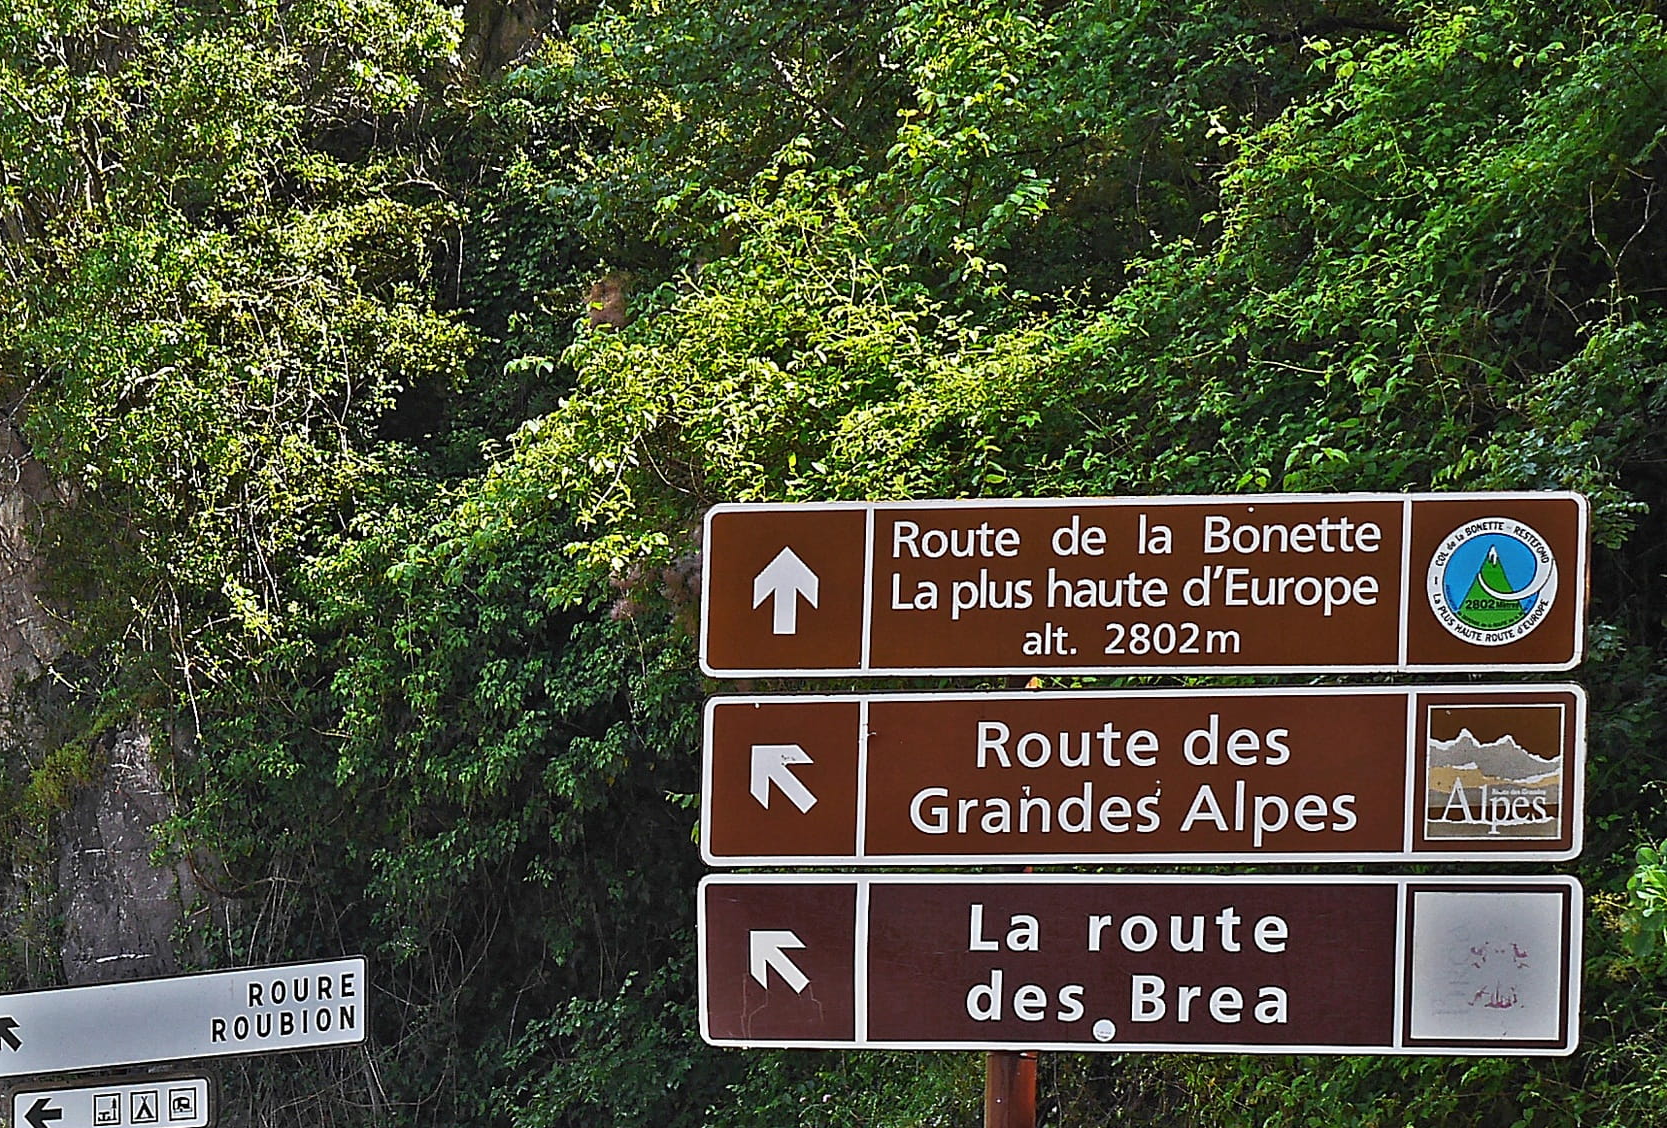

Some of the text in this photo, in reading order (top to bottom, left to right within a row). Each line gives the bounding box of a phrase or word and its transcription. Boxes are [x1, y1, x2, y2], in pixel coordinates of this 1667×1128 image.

[892, 514, 1382, 558] Route de la Bonette
[1435, 551, 1450, 567] COL
[1464, 521, 1505, 537] BONETTE
[1513, 526, 1550, 564] RESTEFOND
[891, 565, 1380, 618] La plus haute d'Europe
[1465, 600, 1497, 610] 2802
[1022, 622, 1077, 655] alt.
[1437, 604, 1456, 627] PLUS
[1453, 622, 1483, 642] HAUTE
[1484, 628, 1516, 643] ROUTE
[977, 714, 1290, 768] Route des
[909, 780, 1358, 848] Grandes Alpes
[1442, 777, 1548, 835] Alpes
[969, 904, 1288, 953] La route
[248, 973, 356, 1008] ROURE
[966, 969, 1288, 1024] des Brea
[211, 1005, 356, 1043] ROUBION
